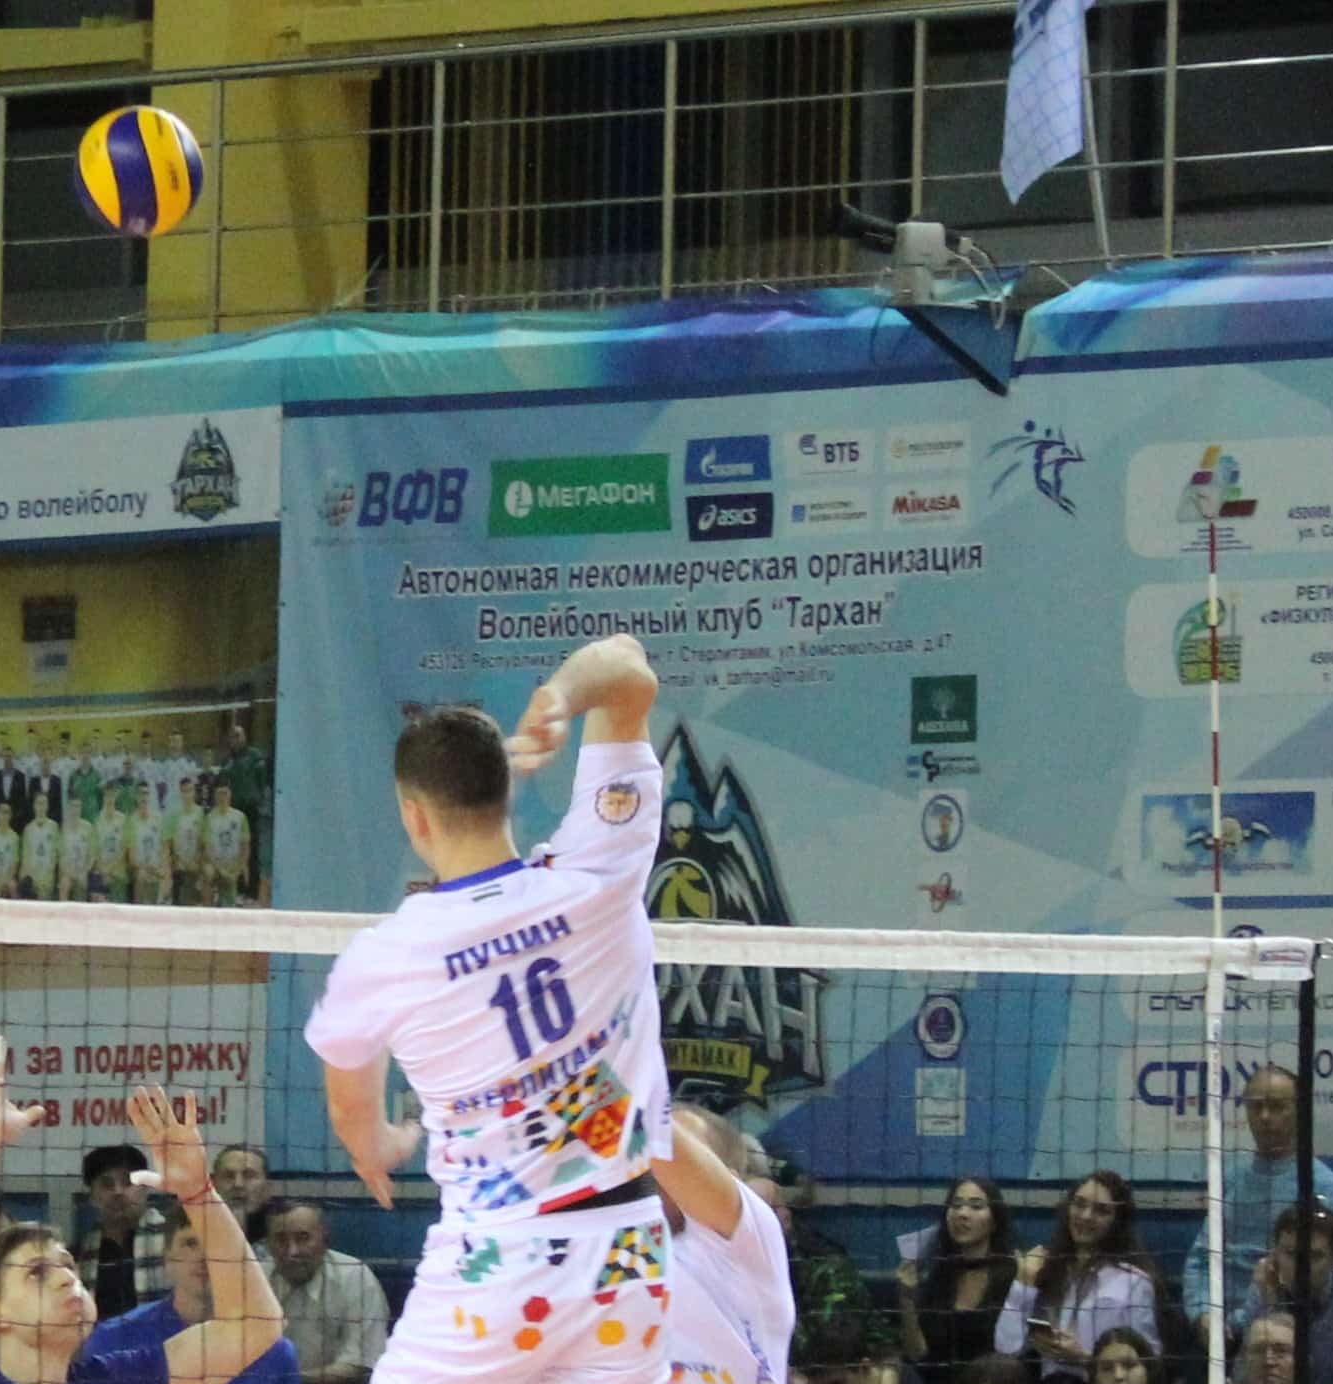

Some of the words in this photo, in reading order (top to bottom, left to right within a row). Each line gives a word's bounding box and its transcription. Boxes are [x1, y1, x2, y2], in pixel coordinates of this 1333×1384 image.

[824, 442, 860, 464] ВТБ
[18, 487, 147, 520] волейболу
[357, 468, 469, 528] ВФВ
[717, 507, 757, 526] asics
[398, 562, 558, 595] Автономная
[568, 555, 797, 591] некоммерческая
[808, 545, 983, 585] организация
[477, 602, 687, 641] Волейбольный
[697, 601, 763, 637] клуб
[489, 957, 575, 1062] 16
[26, 1047, 63, 1075] за
[75, 1041, 250, 1080] поддержку
